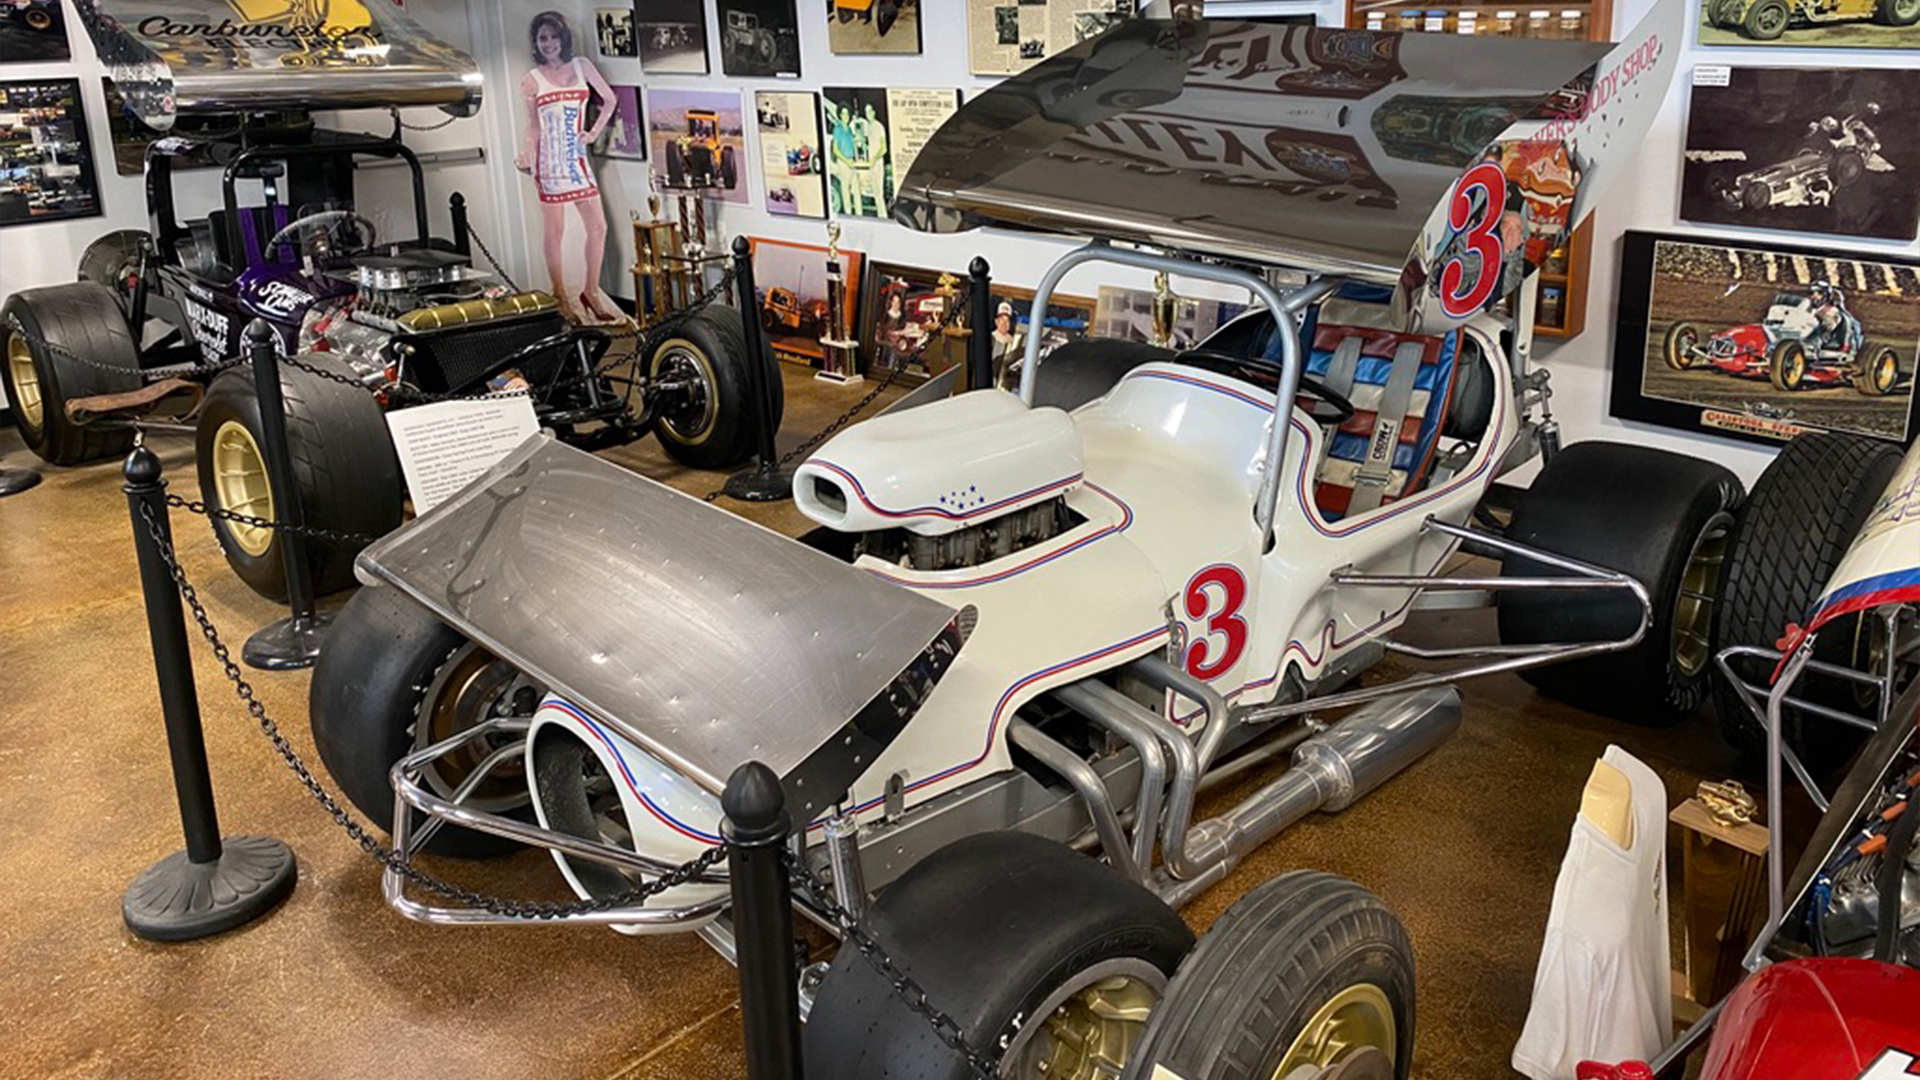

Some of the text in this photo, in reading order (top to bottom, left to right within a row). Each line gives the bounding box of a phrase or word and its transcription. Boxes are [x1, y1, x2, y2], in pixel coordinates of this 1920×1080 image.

[137, 15, 383, 46] Carburetor
[1621, 34, 1658, 87] SHOP
[563, 105, 581, 185] Budweiser
[1440, 160, 1507, 319] 3
[1183, 562, 1249, 684] 3
